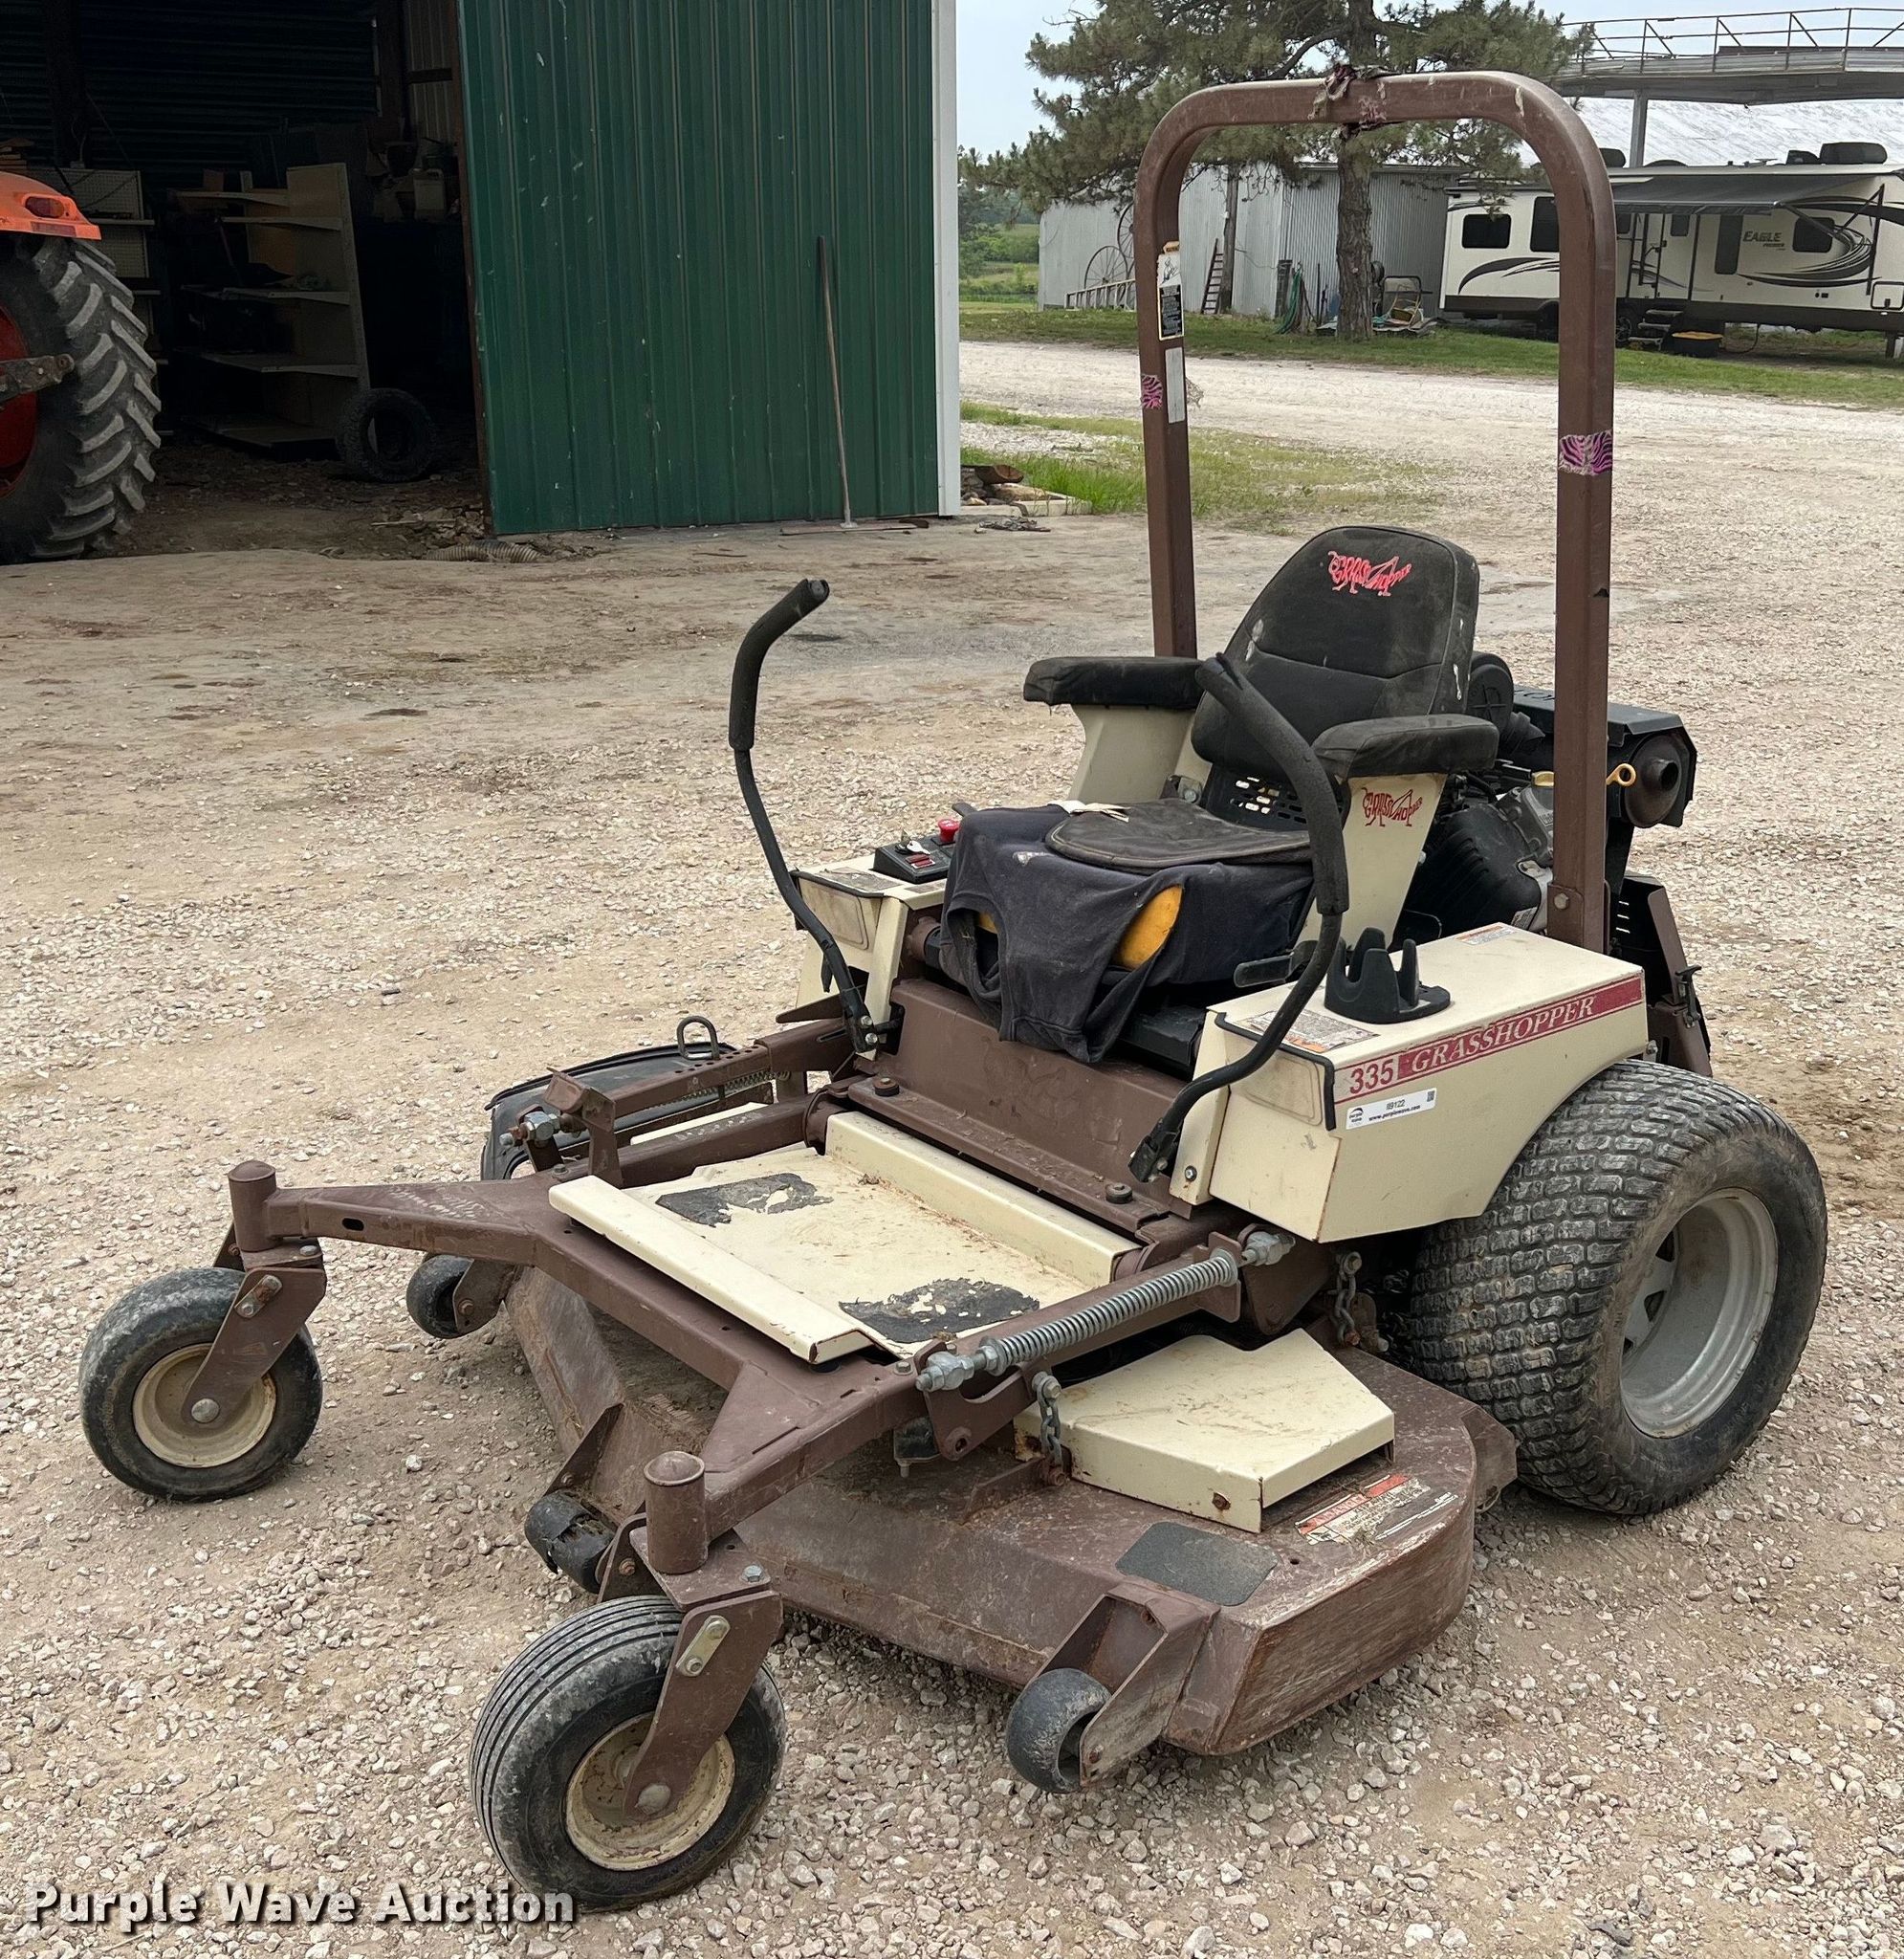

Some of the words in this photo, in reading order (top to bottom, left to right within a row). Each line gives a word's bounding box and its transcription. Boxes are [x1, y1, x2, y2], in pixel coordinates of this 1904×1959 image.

[1743, 231, 1783, 242] EAGLE
[1349, 1058, 1393, 1094] 335
[1412, 996, 1596, 1073] GRASSHOPPER
